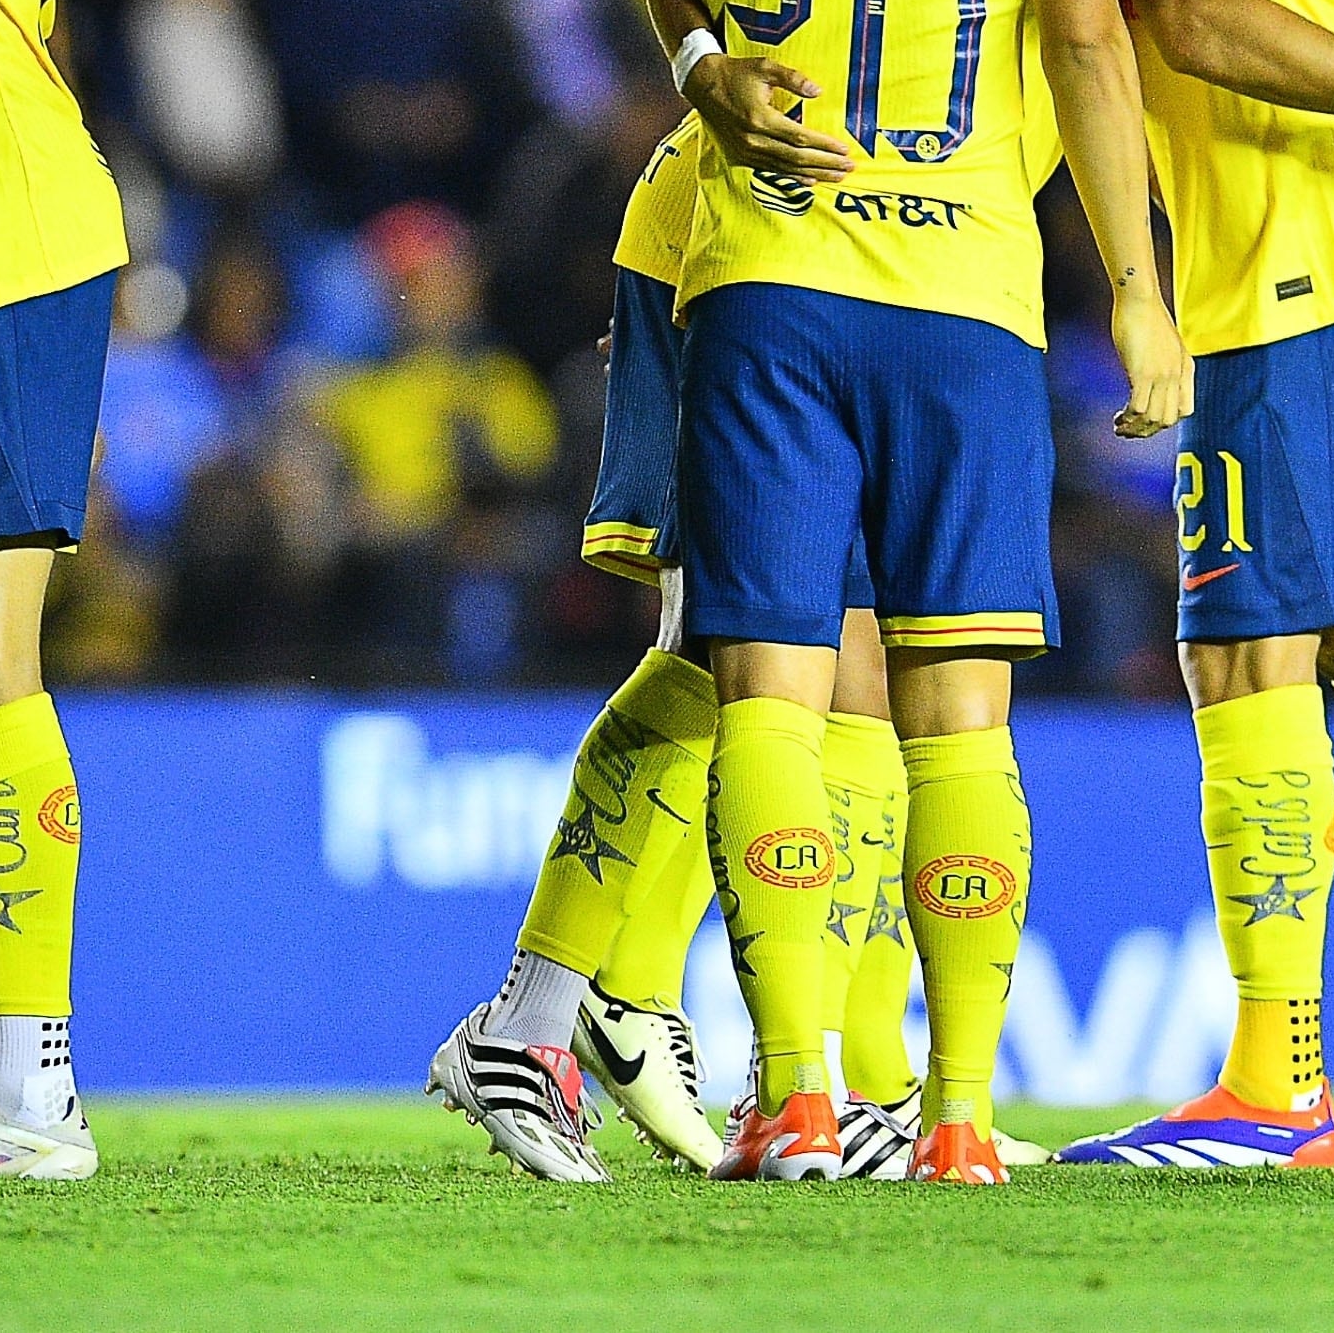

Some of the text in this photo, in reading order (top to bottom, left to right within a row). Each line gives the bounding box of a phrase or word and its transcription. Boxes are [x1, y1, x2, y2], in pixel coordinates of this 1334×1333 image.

[834, 190, 965, 231] AT&T
[1175, 450, 1253, 553] 21
[775, 845, 819, 872] CA
[939, 874, 990, 902] CA
